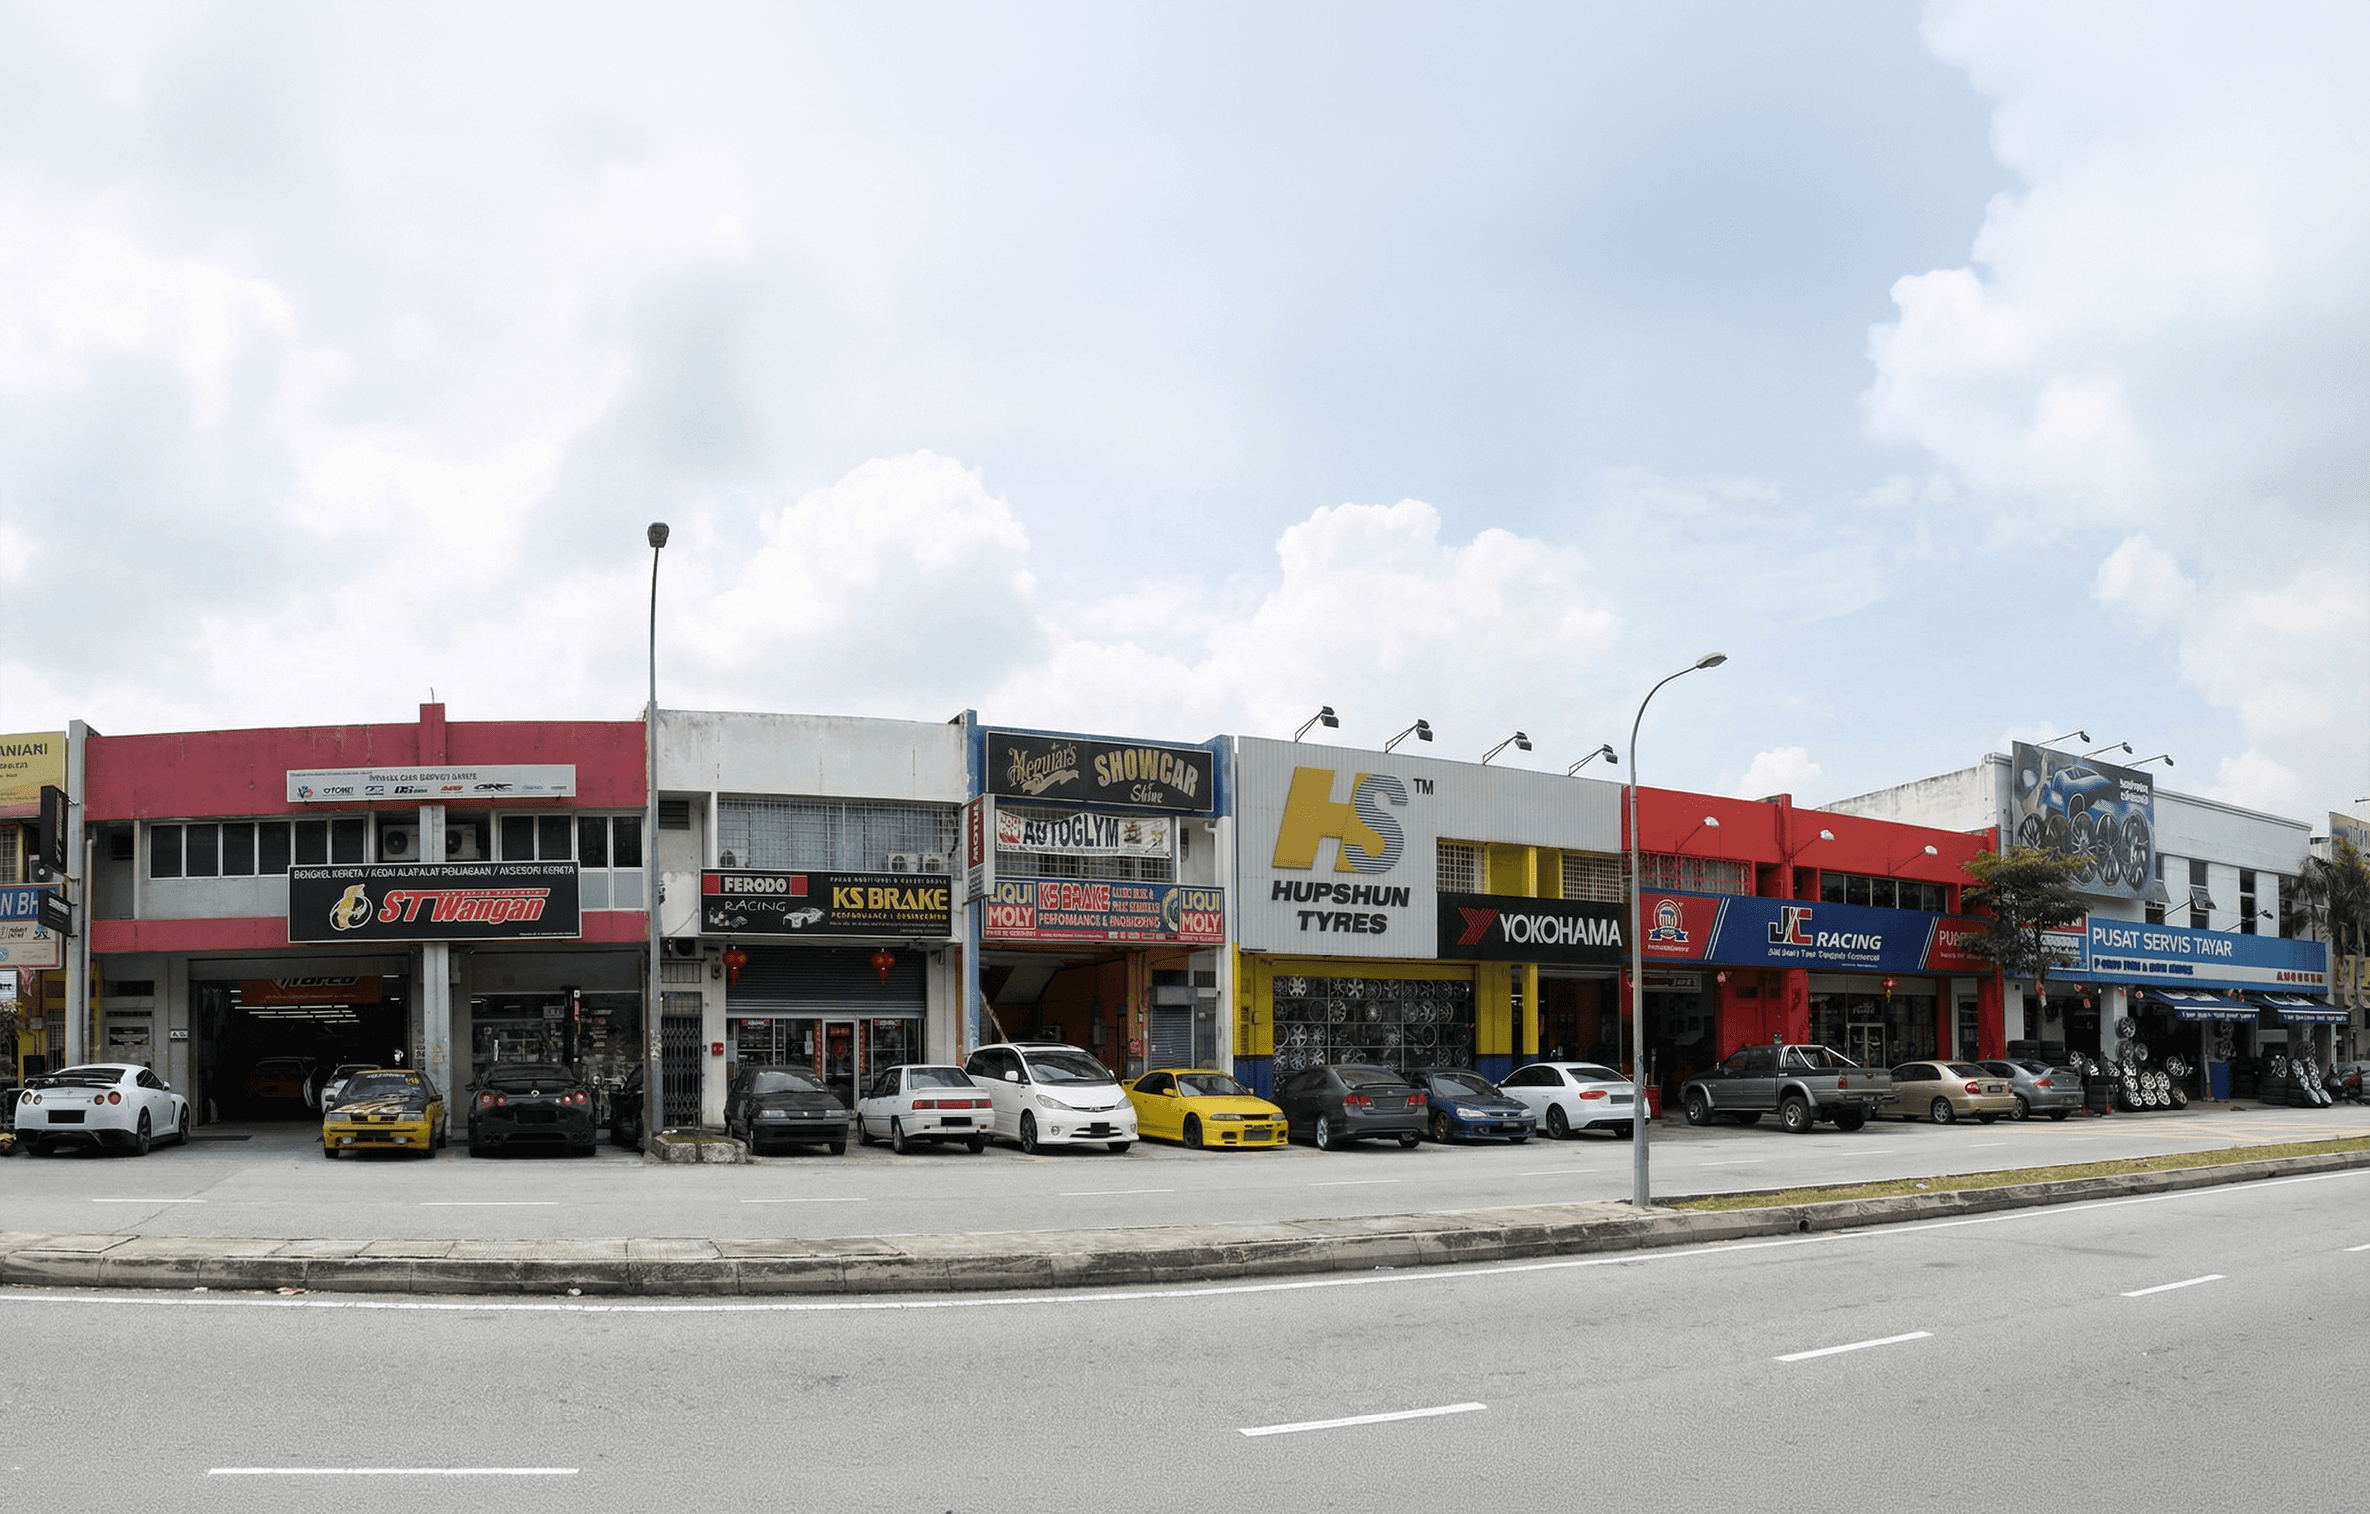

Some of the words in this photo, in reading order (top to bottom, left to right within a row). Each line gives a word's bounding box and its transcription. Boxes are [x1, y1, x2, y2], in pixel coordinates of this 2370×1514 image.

[1094, 748, 1199, 798] SHOWCAR
[1413, 778, 1434, 795] TM
[1022, 813, 1119, 848] AUTOGLYM
[1272, 766, 1409, 875] HS
[724, 877, 787, 893] FERODO
[1038, 882, 1061, 910] KS
[1061, 883, 1111, 912] BRAKE
[1271, 880, 1411, 908] HUPSHUN
[431, 896, 546, 925] Wangan
[724, 899, 787, 912] RACING
[833, 886, 865, 910] KS
[867, 887, 949, 911] BRAKE
[1182, 891, 1220, 912] LIQUI
[988, 906, 1033, 927] MOLY
[1182, 912, 1221, 933] MOLY
[1297, 910, 1388, 935] TYRES
[1499, 913, 1623, 947] YOKOHAMA
[1816, 931, 1882, 951] RACING
[2092, 926, 2140, 949] PUSAT
[2143, 932, 2191, 954] SERVIS
[2192, 936, 2233, 958] TAYAR
